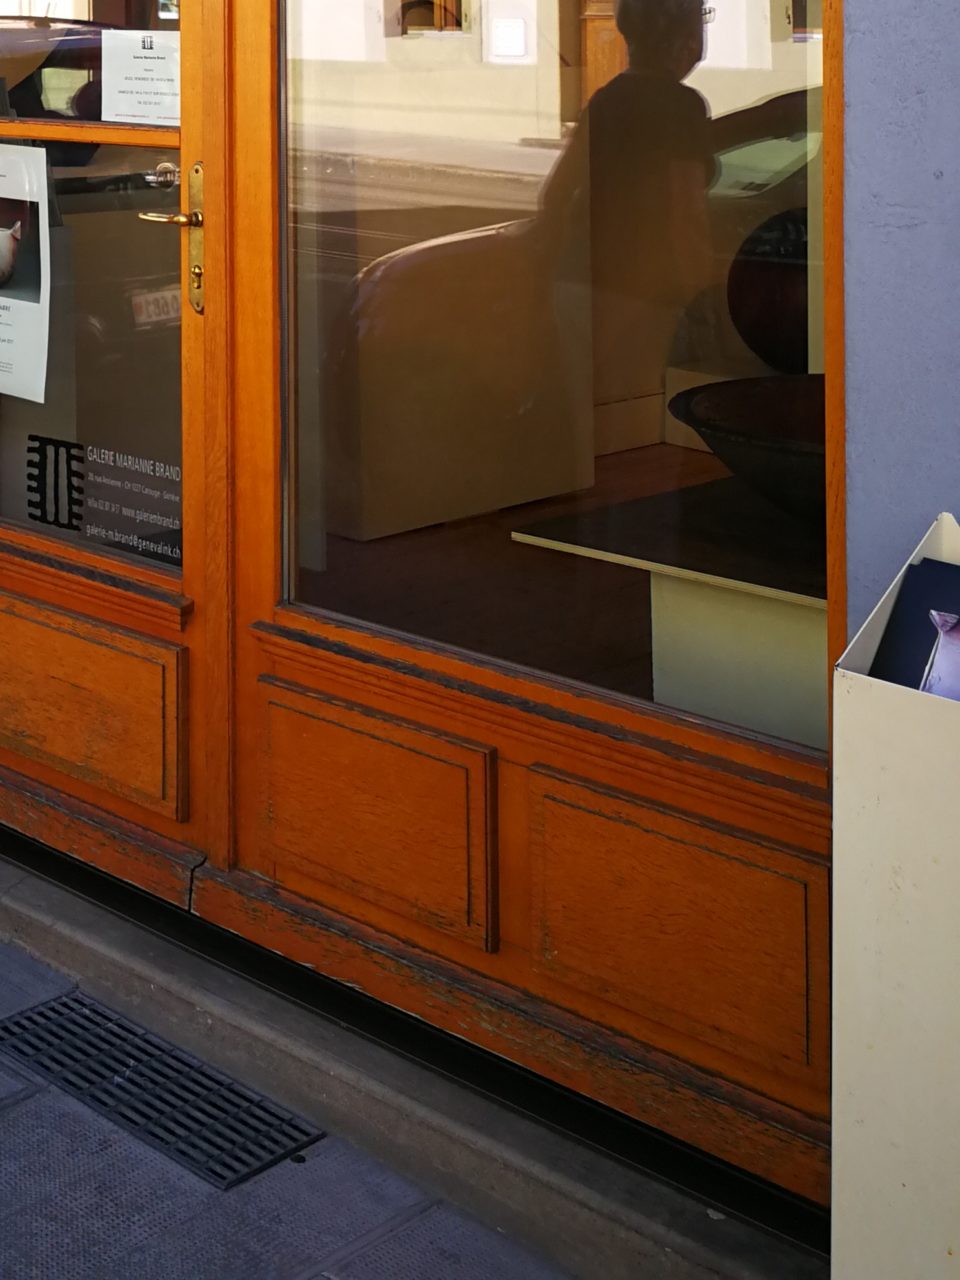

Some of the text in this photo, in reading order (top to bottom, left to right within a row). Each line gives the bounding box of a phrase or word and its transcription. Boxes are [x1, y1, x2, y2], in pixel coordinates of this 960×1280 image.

[87, 445, 181, 481] GALERIE MARIANNE BRAND
